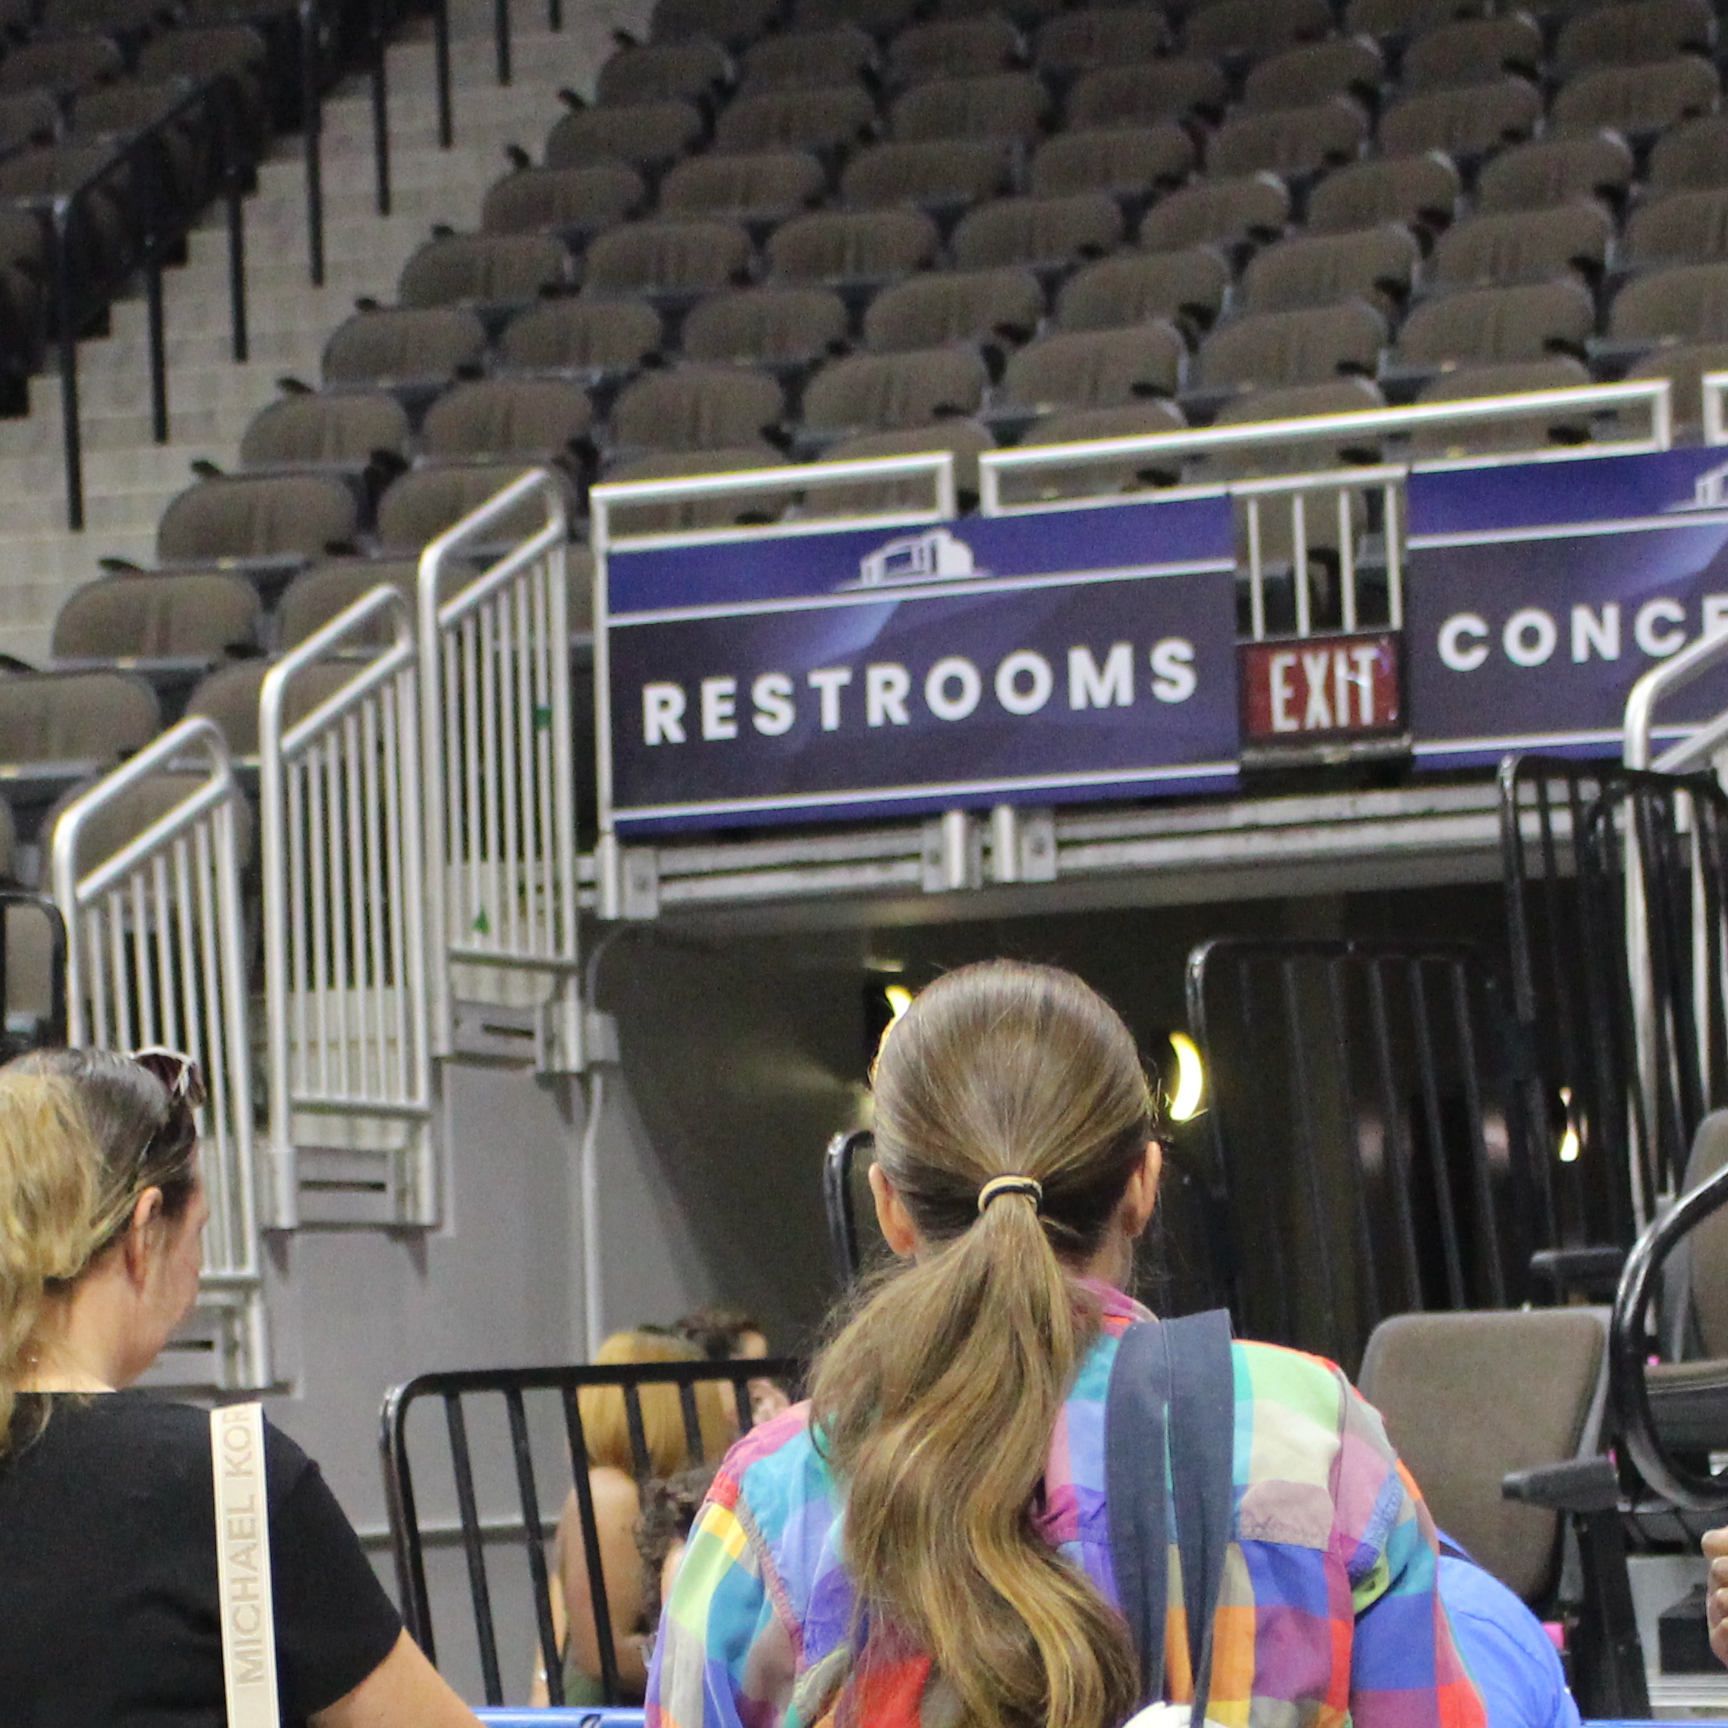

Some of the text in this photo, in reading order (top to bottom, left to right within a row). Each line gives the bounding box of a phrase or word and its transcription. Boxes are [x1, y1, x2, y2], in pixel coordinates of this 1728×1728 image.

[642, 637, 1197, 746] RESTROOMS
[1270, 645, 1380, 733] EXIT
[227, 1494, 265, 1687] MICHAEL
